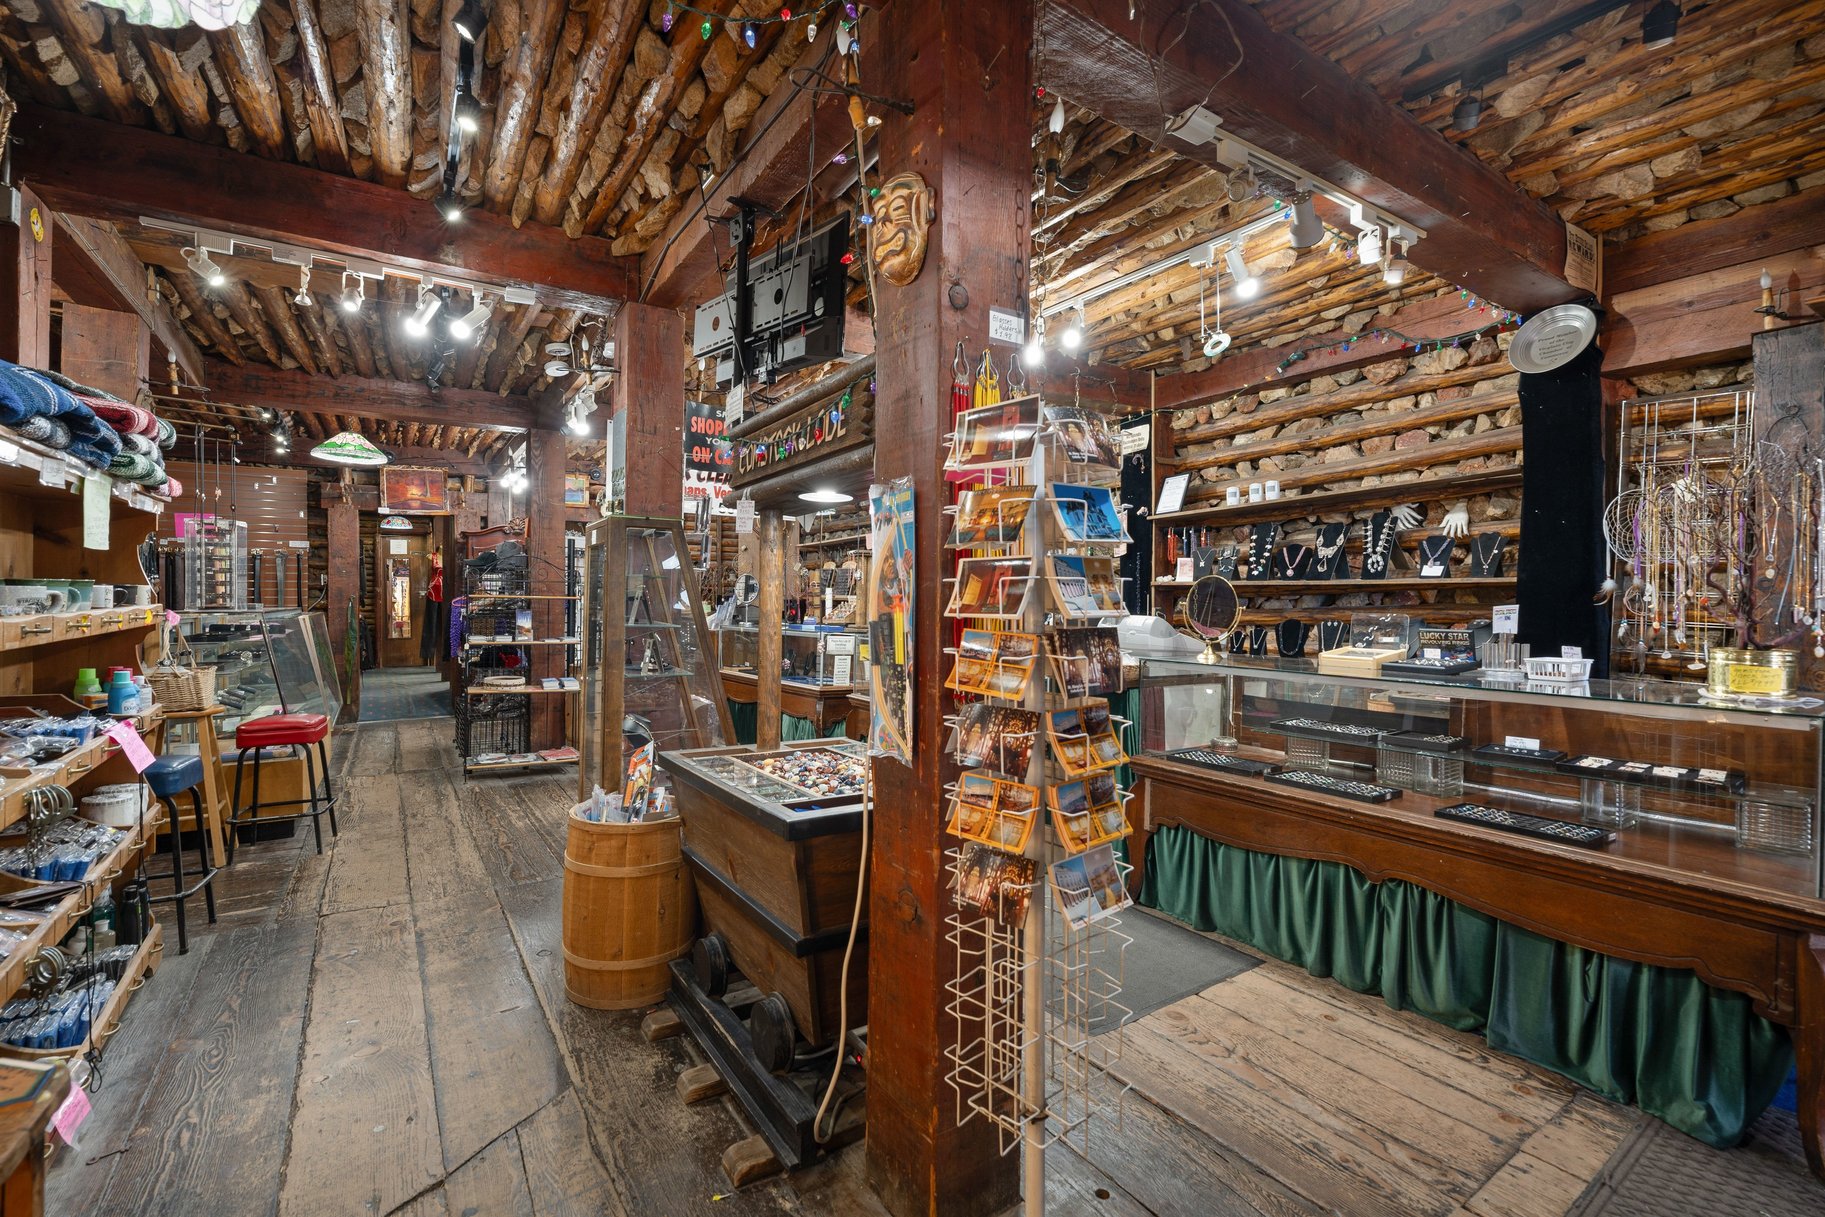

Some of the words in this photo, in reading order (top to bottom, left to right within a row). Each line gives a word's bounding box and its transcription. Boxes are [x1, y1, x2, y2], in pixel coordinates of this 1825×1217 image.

[806, 400, 847, 450] LODE
[692, 446, 710, 464] ON
[1419, 632, 1446, 640] LUCKY
[1447, 633, 1470, 641] STAR
